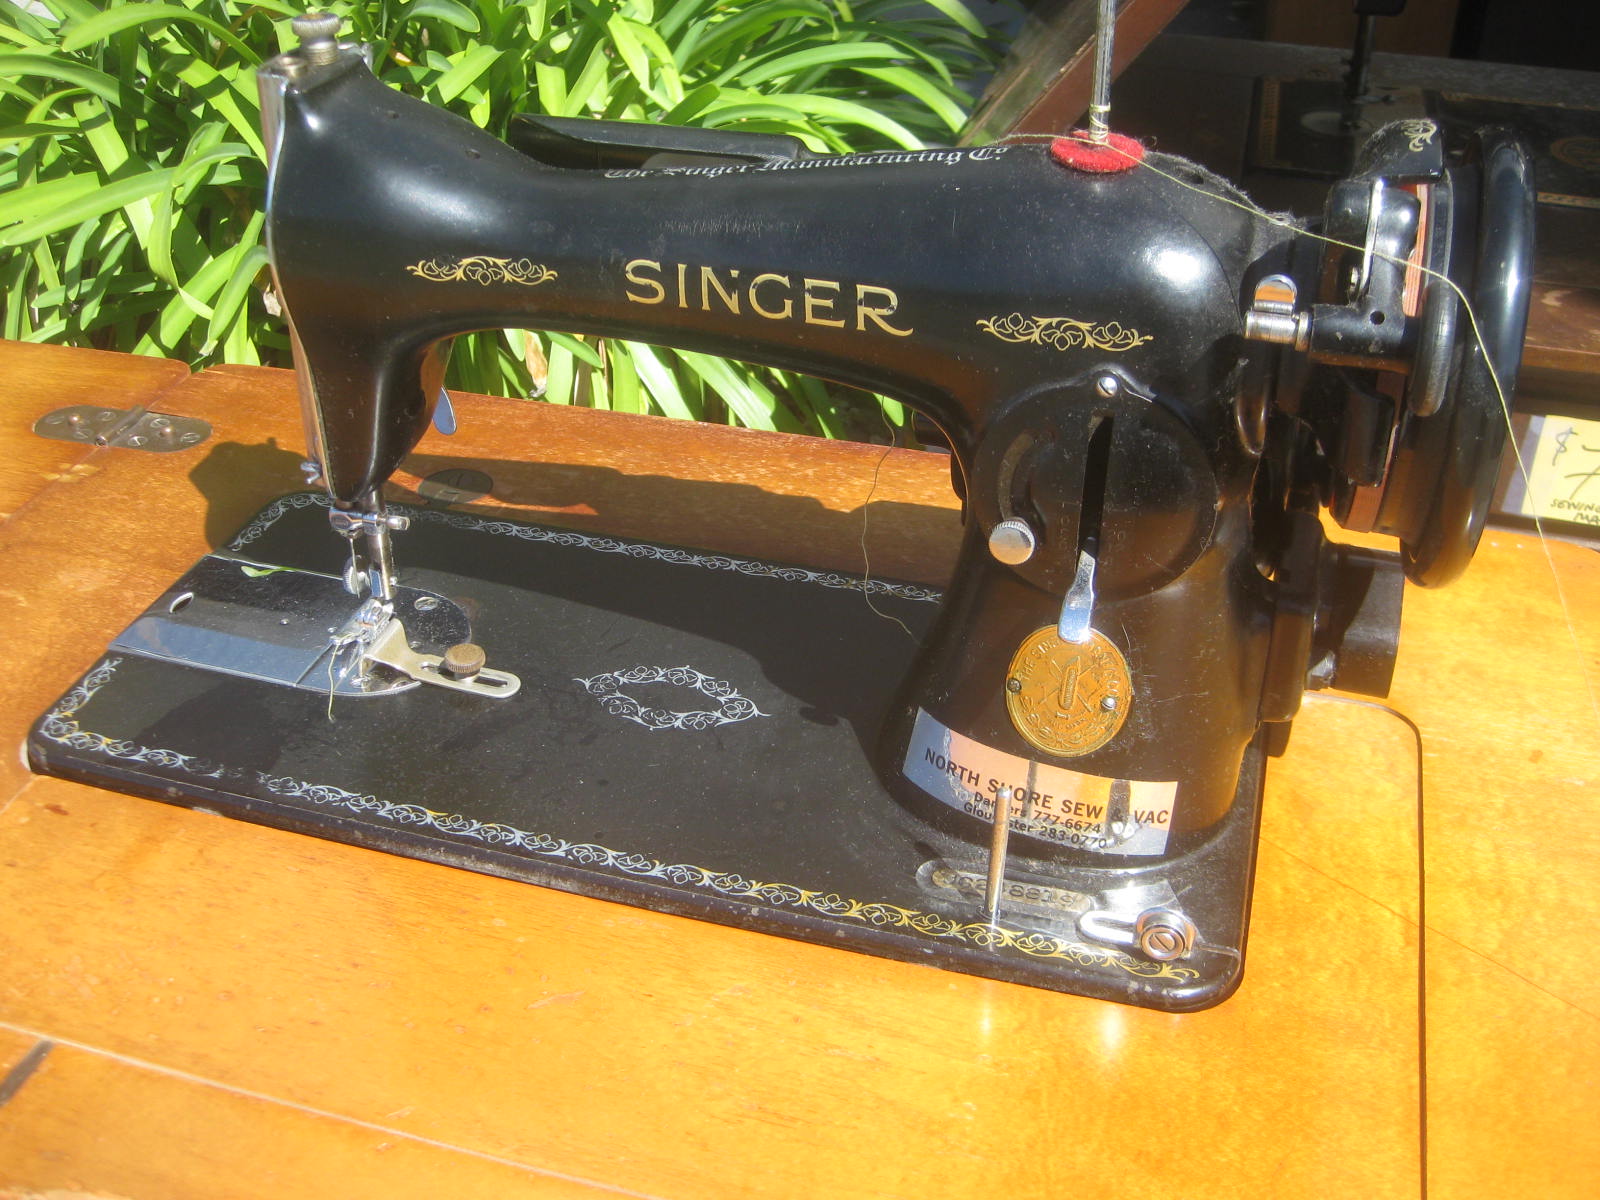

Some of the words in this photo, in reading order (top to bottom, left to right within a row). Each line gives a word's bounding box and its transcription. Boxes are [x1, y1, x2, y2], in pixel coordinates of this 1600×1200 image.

[624, 258, 914, 337] SINGER
[924, 747, 981, 787] NORTH
[986, 778, 1055, 810] SORE
[1060, 799, 1103, 820] SEW
[1133, 809, 1169, 825] VAC
[963, 802, 1034, 832] Glouster
[1038, 825, 1107, 849] 283-0770
[1033, 809, 1101, 835] 777-6674
